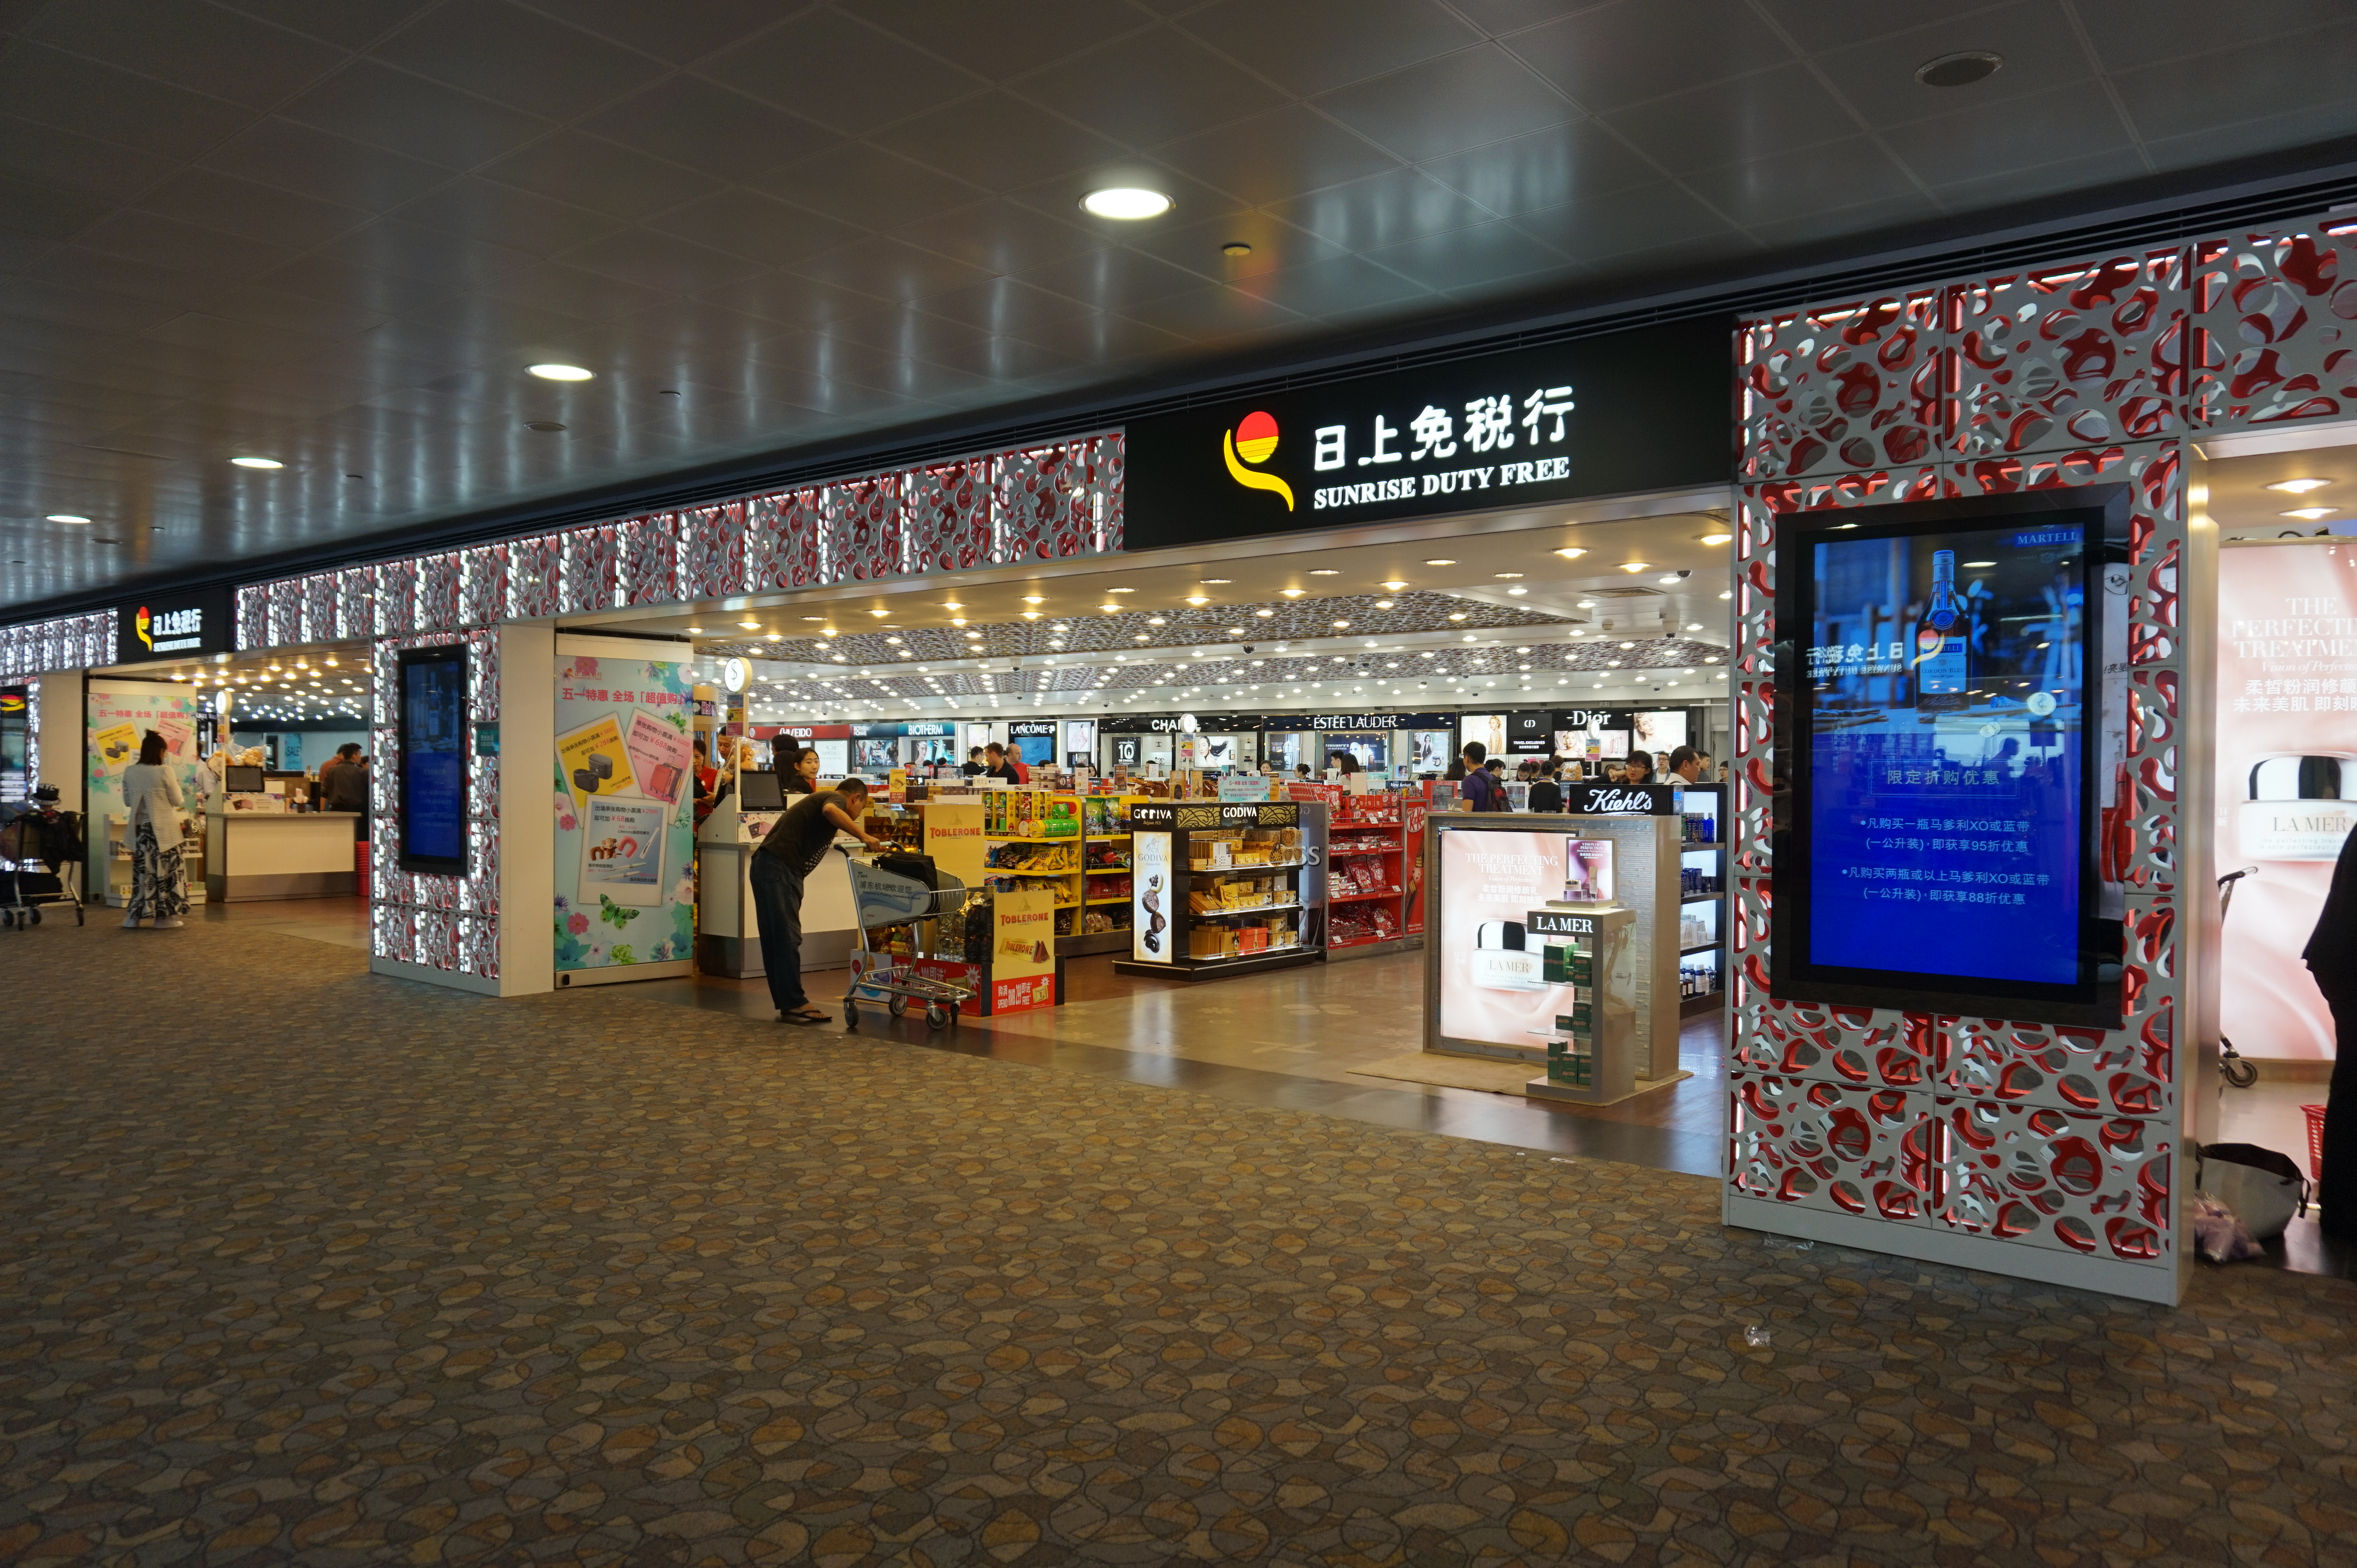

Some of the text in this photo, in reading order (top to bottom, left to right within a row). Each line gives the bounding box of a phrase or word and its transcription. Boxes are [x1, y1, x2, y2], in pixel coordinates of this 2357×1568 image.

[1314, 386, 1575, 471] 日上免税行
[1314, 457, 1570, 509] SUNRISE DUTY FREE
[2017, 532, 2078, 545] MARTELL
[2286, 597, 2338, 615] THE
[2262, 661, 2296, 671] Vision
[2299, 660, 2310, 674] of
[562, 688, 609, 701] 五一特惠
[612, 690, 634, 702] 全场
[2233, 696, 2308, 712] 未来美肌
[1152, 719, 1201, 730] CHAL
[1347, 715, 1398, 729] LAUDER
[1572, 710, 1611, 725] Dior
[908, 724, 943, 735] BIOTHERM
[1010, 723, 1048, 734] LANCÔME
[1118, 744, 1134, 760] 10
[1887, 769, 2000, 786] 限定折购优惠
[1584, 788, 1652, 812] Kiehl's
[1223, 807, 1257, 817] GODIVA
[2273, 816, 2347, 832] LA MER
[930, 827, 981, 839] TOBLERONE
[1466, 853, 1558, 866] THE PERFECTING
[1479, 863, 1544, 875] TREATMENT
[860, 880, 912, 894] 浦东机场欢迎您
[1477, 894, 1509, 903] 未来美肌
[1000, 912, 1049, 926] TOBLERONE
[1536, 916, 1593, 933] LA MER
[1005, 941, 1034, 956] TOBLERONE
[1490, 960, 1530, 973] LA MER
[998, 998, 1008, 1009] SPEND
